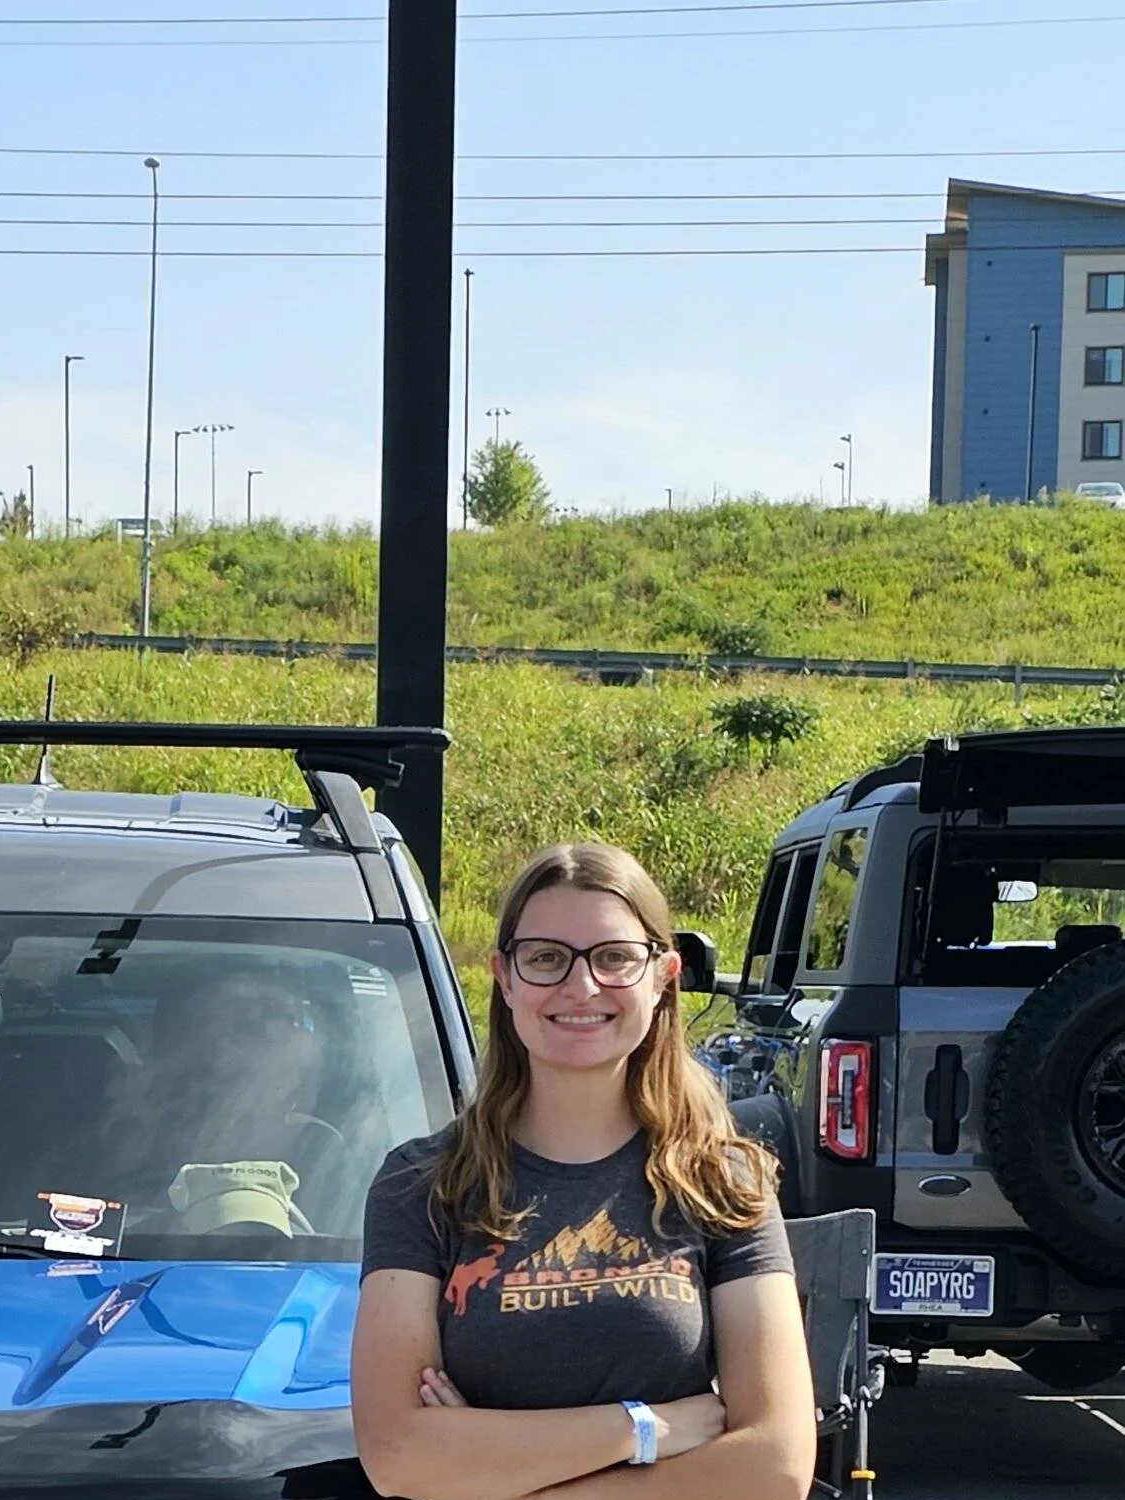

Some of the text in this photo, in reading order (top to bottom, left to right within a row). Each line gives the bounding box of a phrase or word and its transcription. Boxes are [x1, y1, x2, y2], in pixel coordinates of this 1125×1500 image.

[503, 1255, 692, 1286] BRONCO
[888, 1270, 976, 1300] SOAPYRG
[500, 1278, 696, 1313] BUILT WILD
